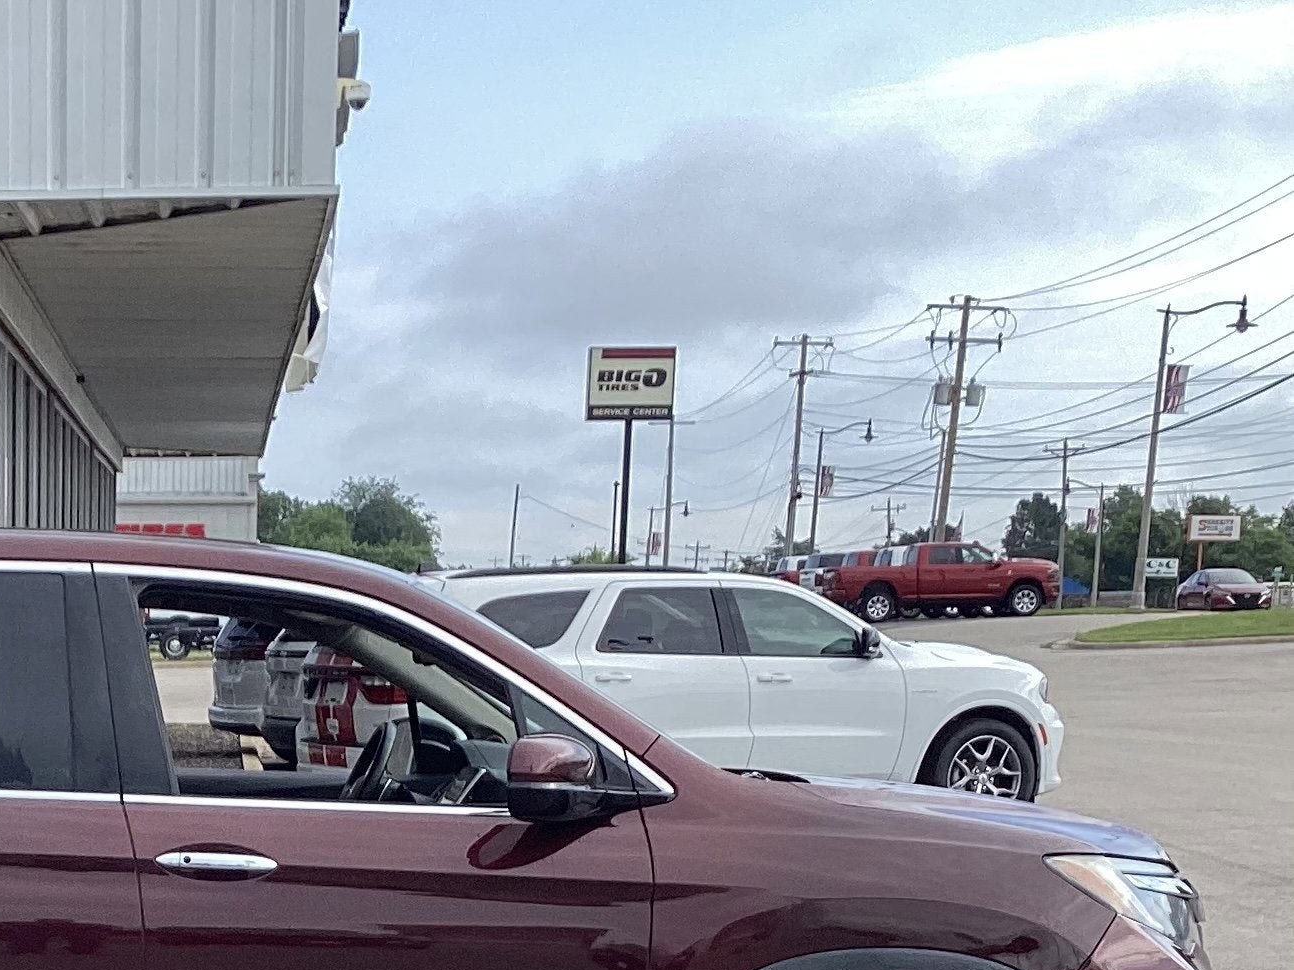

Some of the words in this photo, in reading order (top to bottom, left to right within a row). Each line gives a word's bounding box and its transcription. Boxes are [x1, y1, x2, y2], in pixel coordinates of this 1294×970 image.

[598, 370, 642, 382] BIG
[598, 383, 639, 391] TIRES
[592, 407, 630, 416] SERVICE
[632, 407, 669, 416] CENTER
